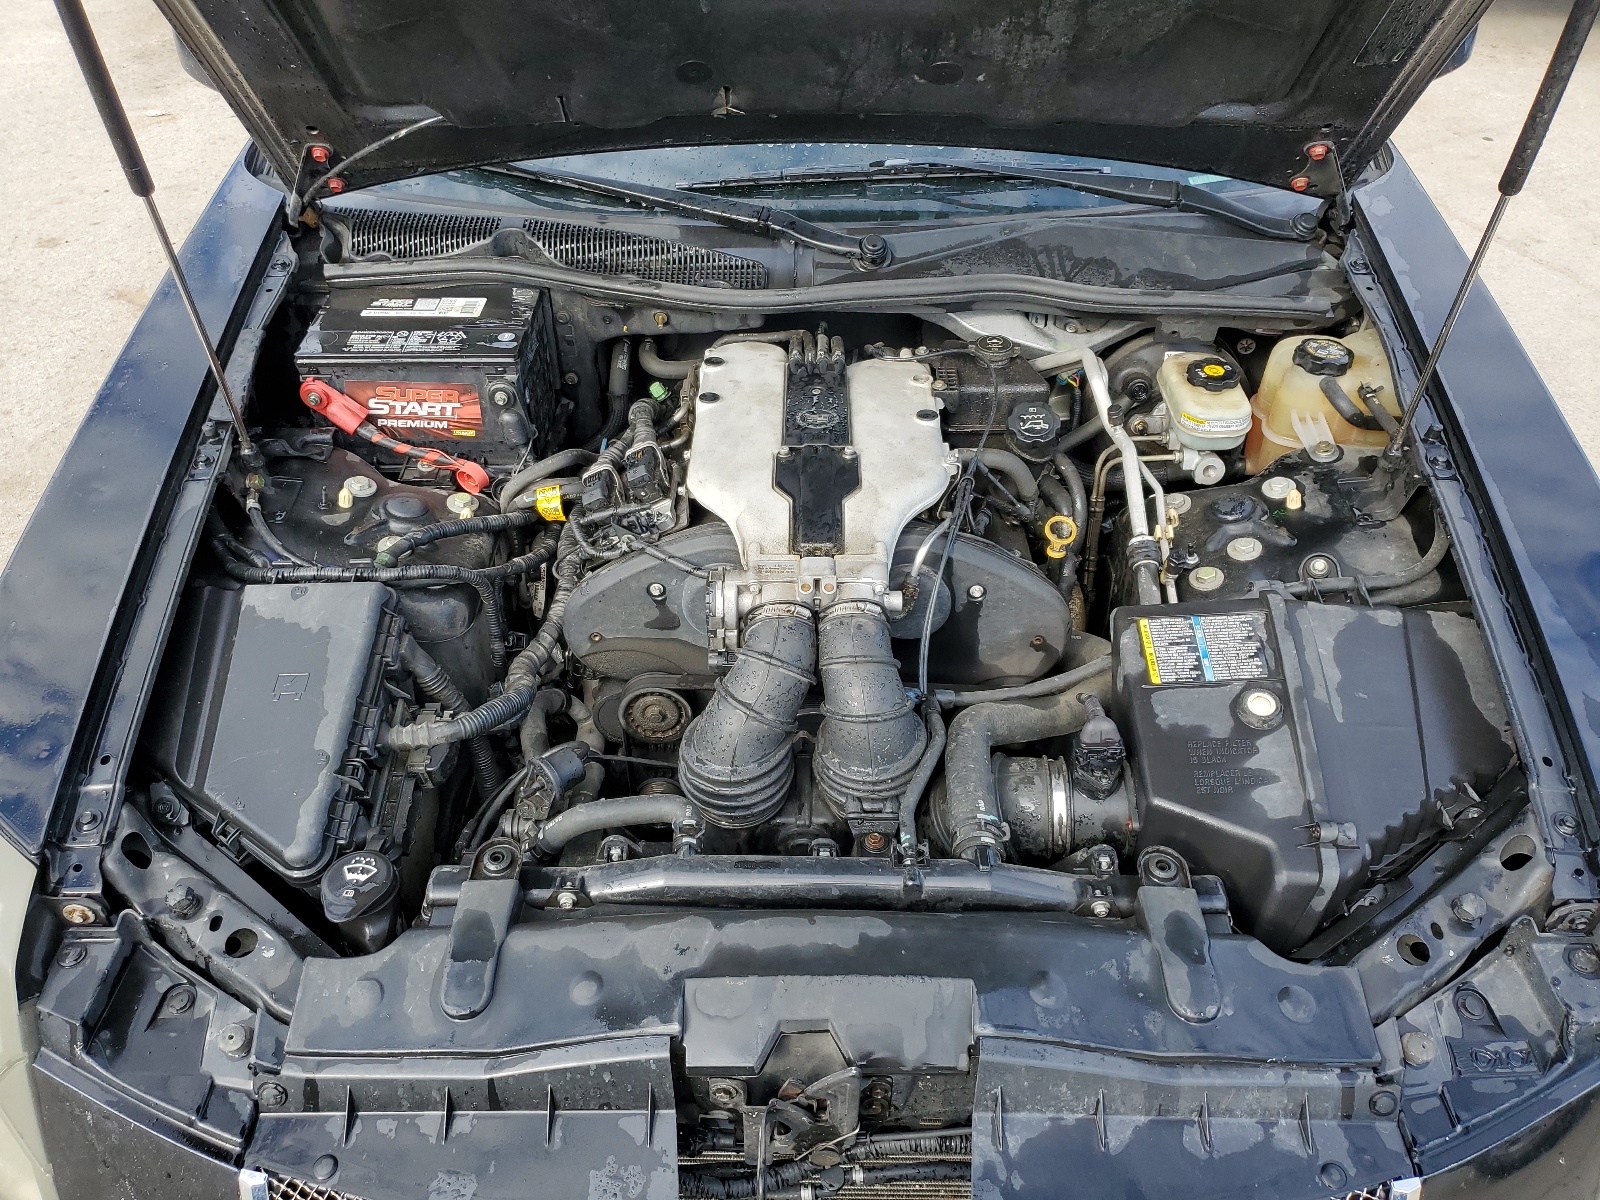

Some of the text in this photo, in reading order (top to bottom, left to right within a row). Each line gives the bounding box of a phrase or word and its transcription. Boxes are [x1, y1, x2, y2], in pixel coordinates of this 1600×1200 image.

[375, 386, 460, 403] SUPER
[368, 398, 462, 416] START
[377, 419, 448, 428] PREMIUM
[1187, 739, 1252, 748] REPLACE FILTER
[1216, 747, 1258, 755] INDICATOR
[1201, 756, 1227, 764] BLACK
